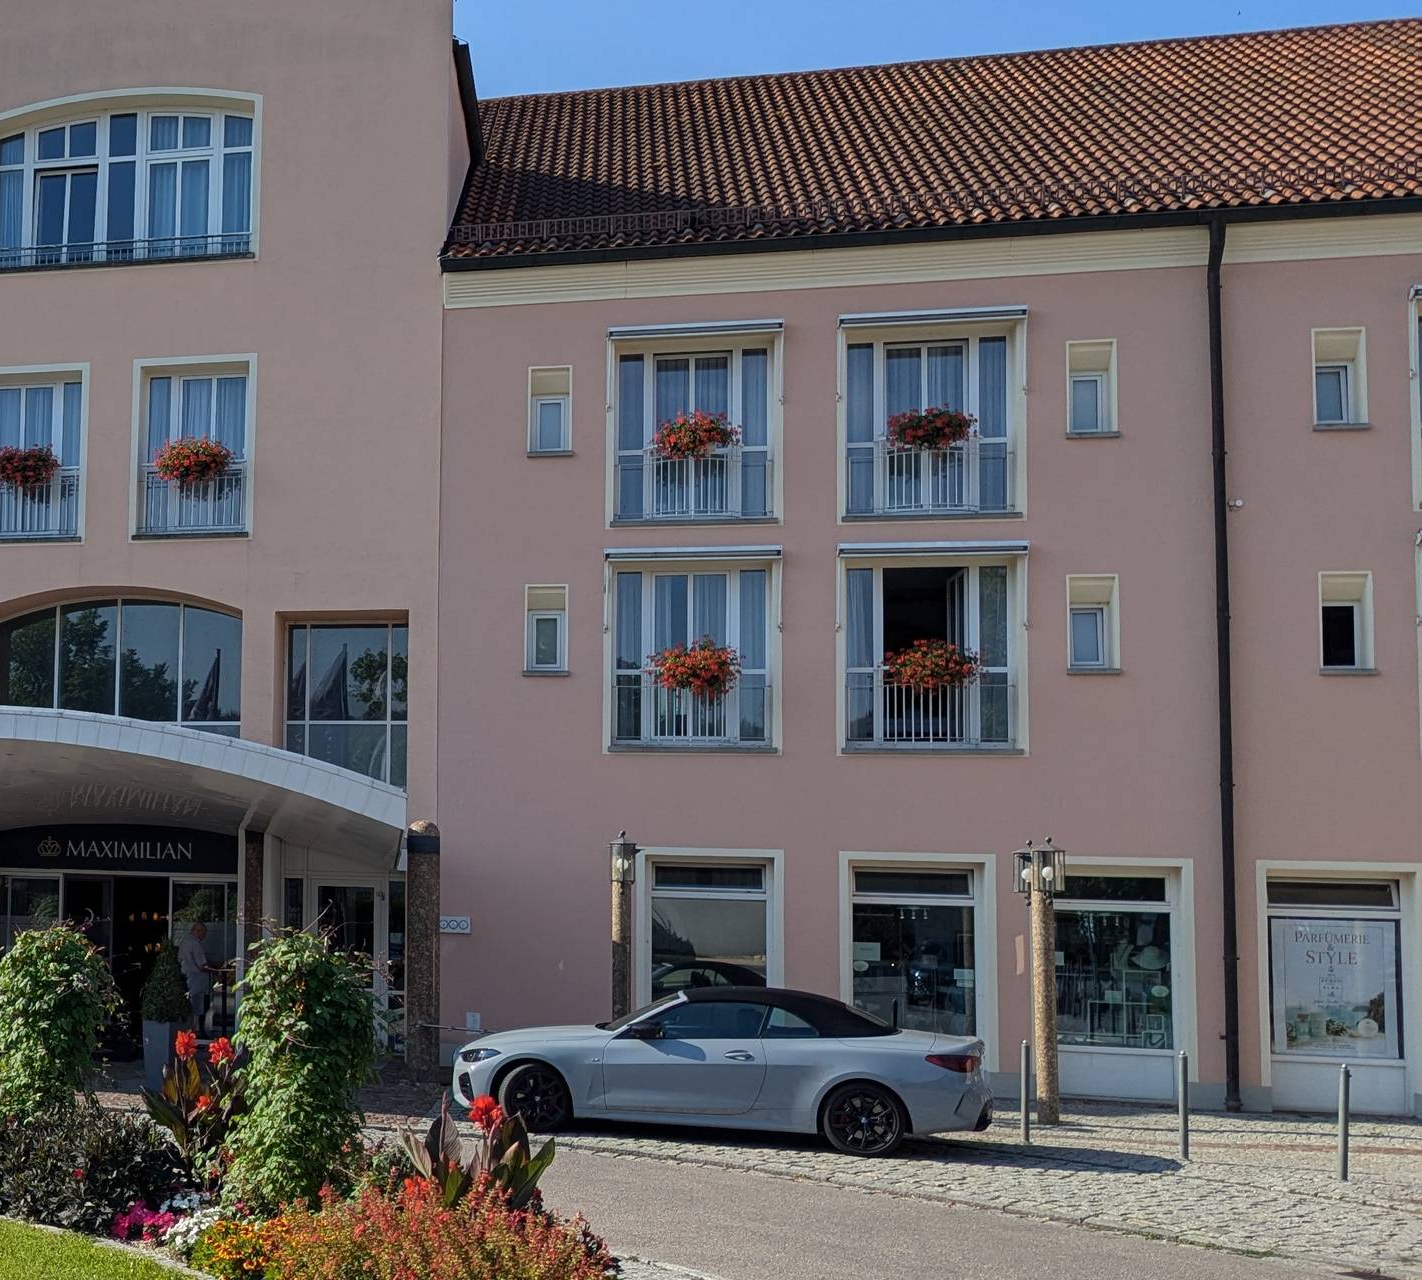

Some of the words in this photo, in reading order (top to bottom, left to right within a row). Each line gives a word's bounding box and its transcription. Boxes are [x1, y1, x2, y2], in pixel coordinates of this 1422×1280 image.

[66, 840, 193, 860] MAXIMILIAN
[1295, 930, 1370, 945] PARFÜMERIE
[1305, 950, 1358, 965] STYLE
